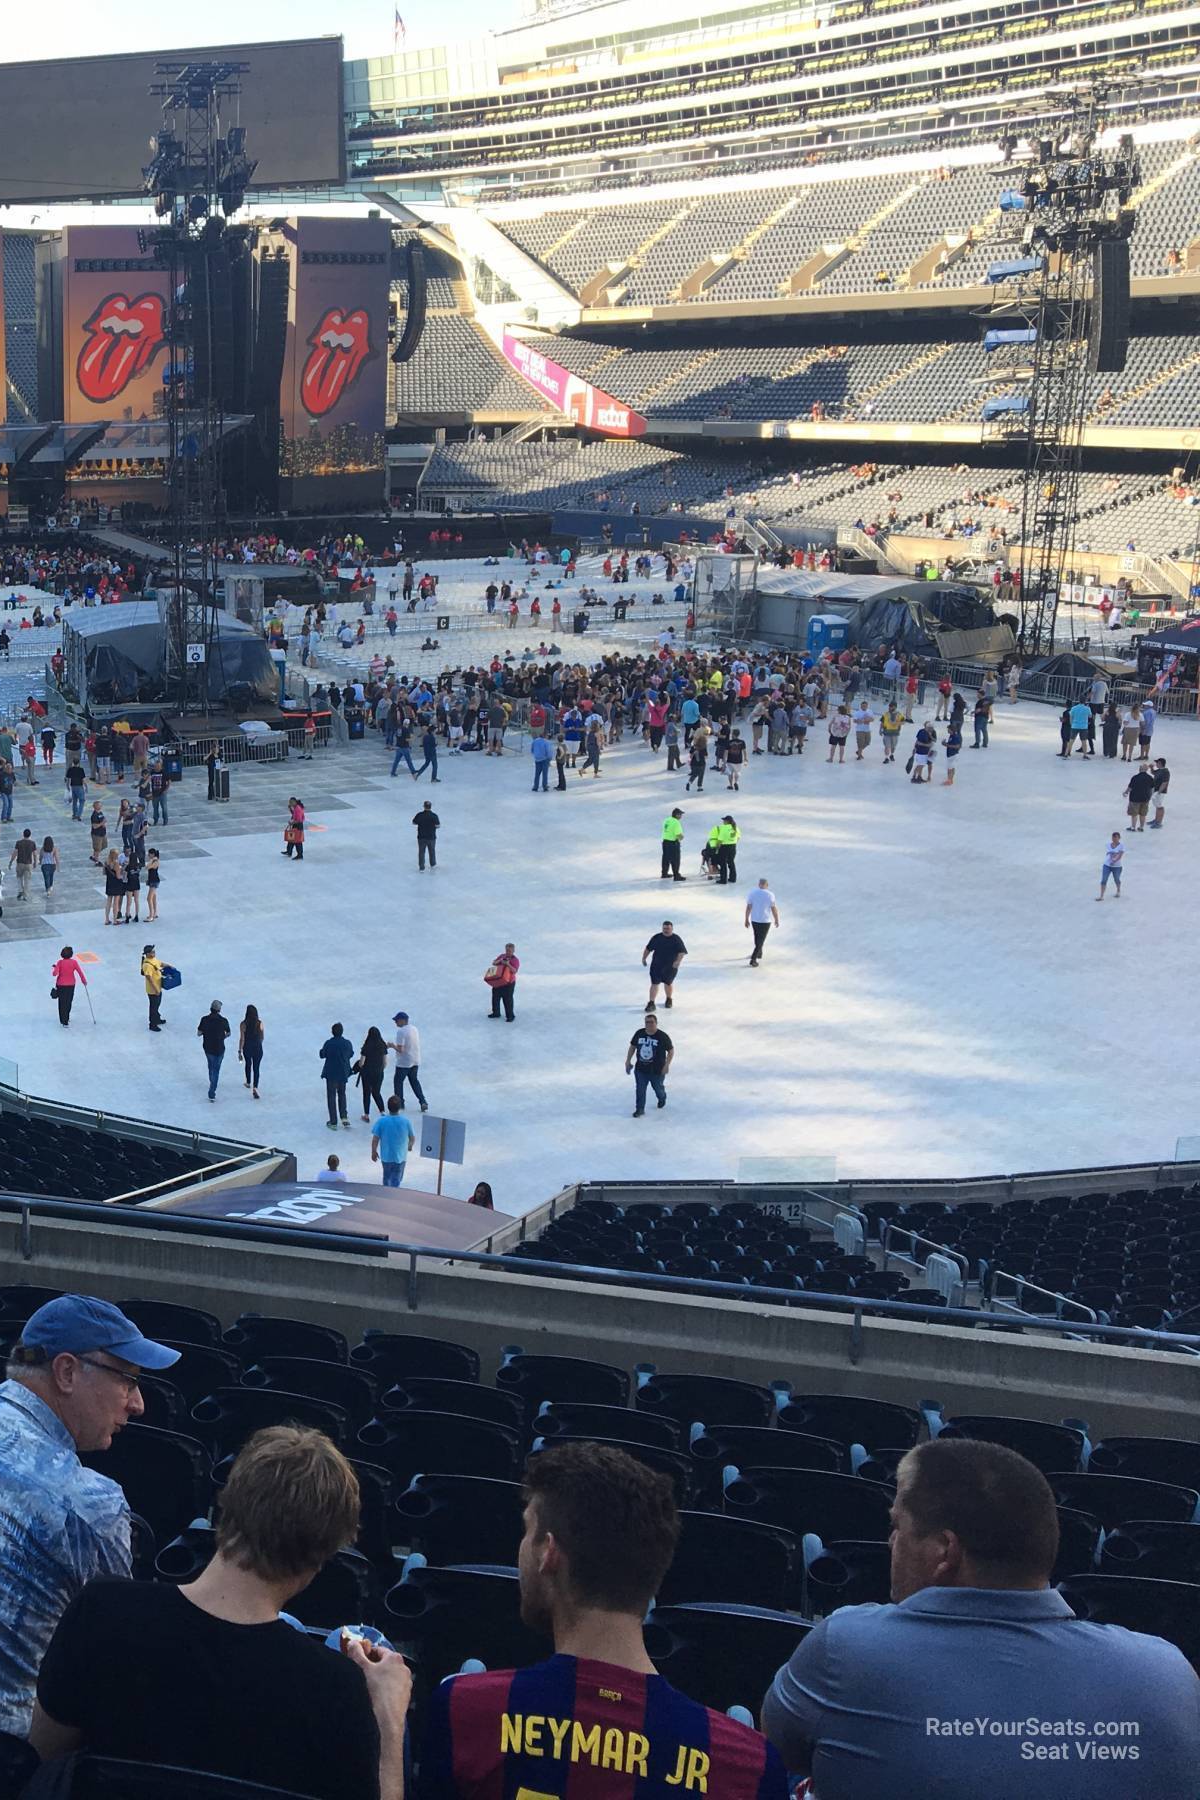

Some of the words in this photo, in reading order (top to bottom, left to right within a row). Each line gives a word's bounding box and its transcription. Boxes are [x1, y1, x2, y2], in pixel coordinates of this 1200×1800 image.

[617, 608, 623, 618] F
[440, 618, 447, 628] C
[763, 1204, 782, 1217] 126
[787, 1204, 800, 1217] 12
[500, 1712, 650, 1778] NEYMAR
[665, 1745, 711, 1793] JR
